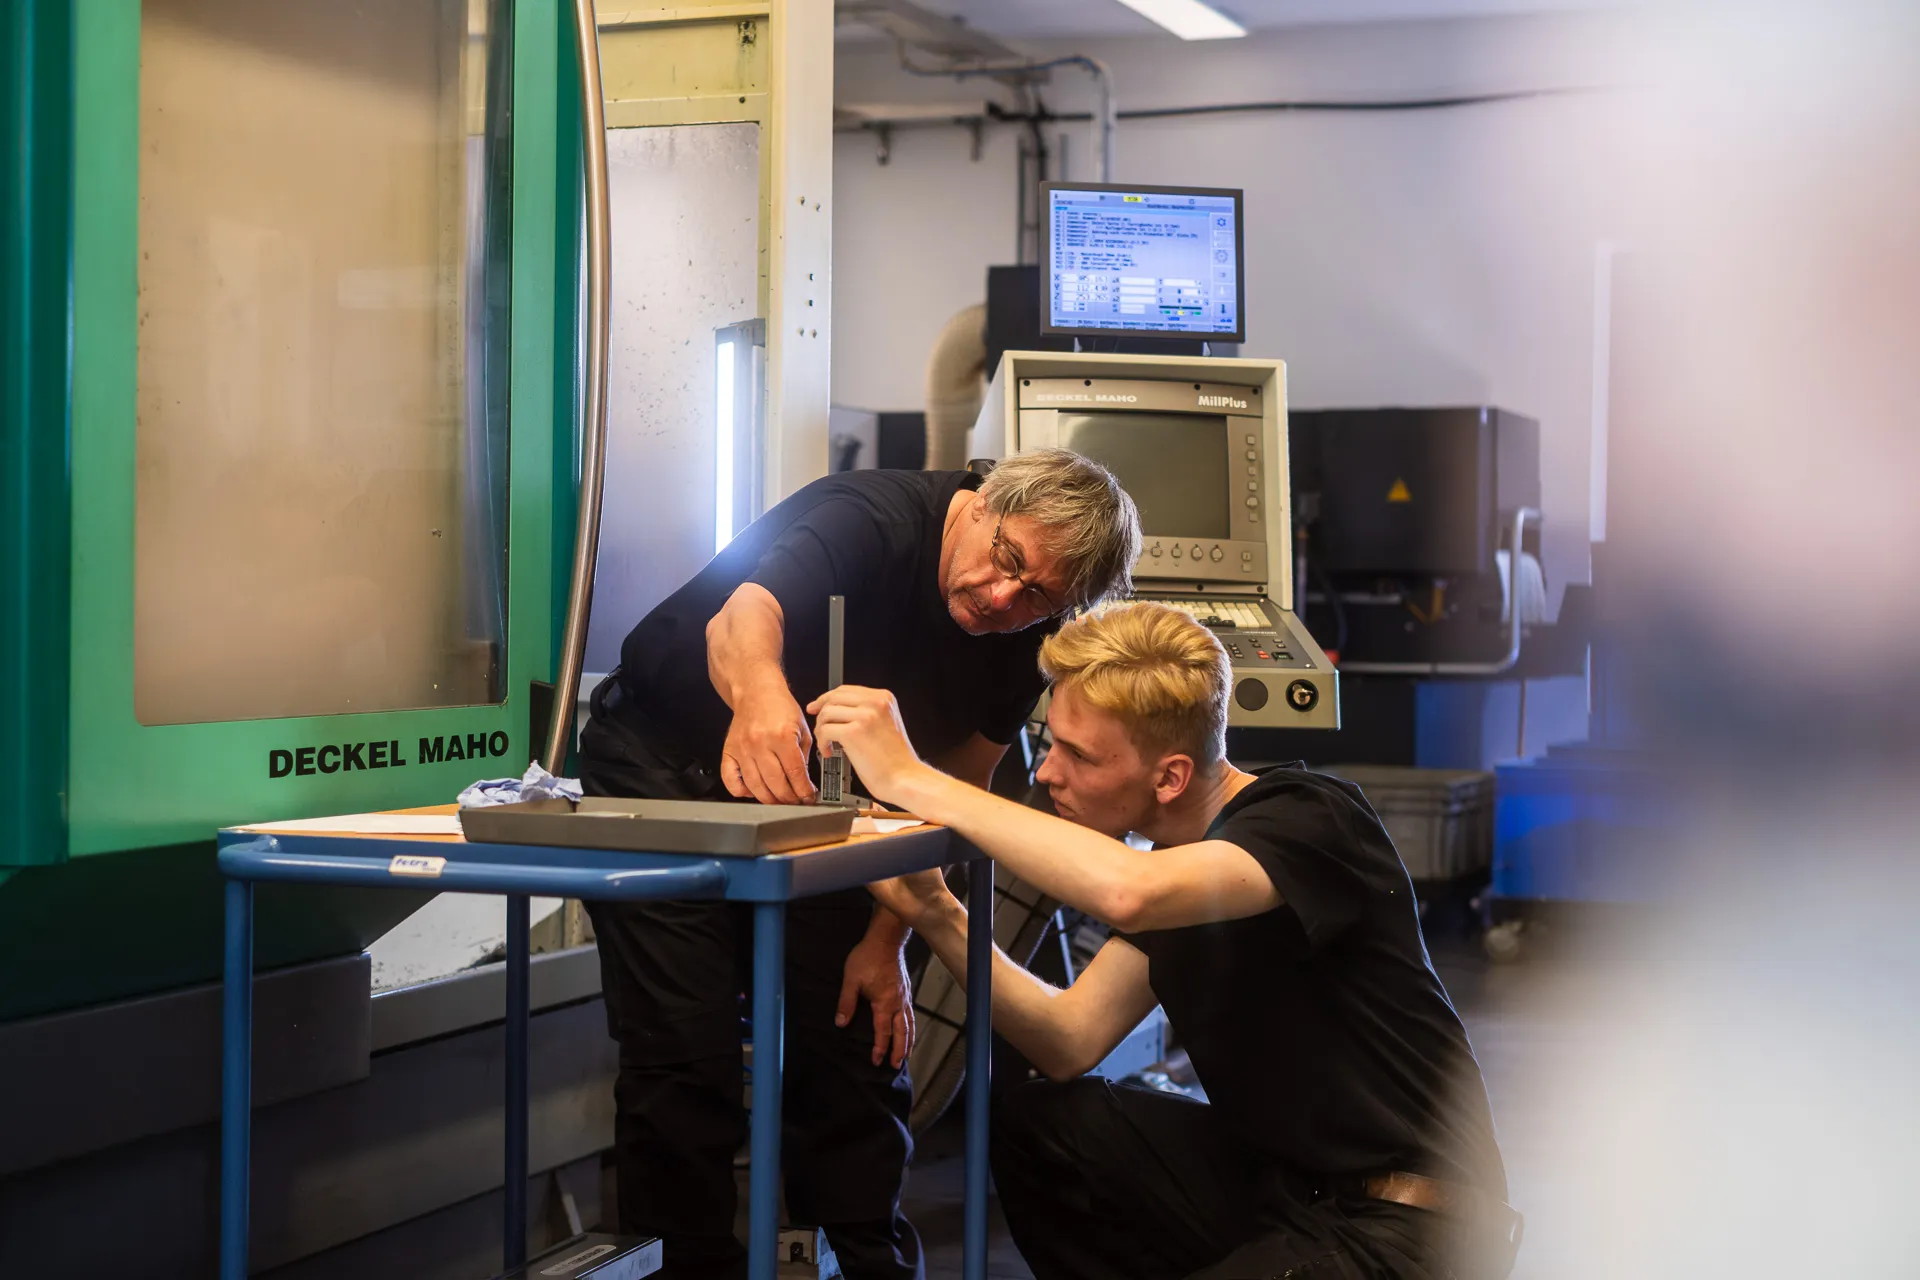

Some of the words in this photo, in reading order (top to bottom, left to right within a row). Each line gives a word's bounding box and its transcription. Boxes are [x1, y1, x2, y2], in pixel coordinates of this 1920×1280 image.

[1036, 394, 1092, 402] DECKEL
[1095, 394, 1137, 403] MAHO
[1198, 396, 1247, 409] MillPlus
[269, 740, 406, 779] DECKEL
[419, 730, 509, 764] MAHO
